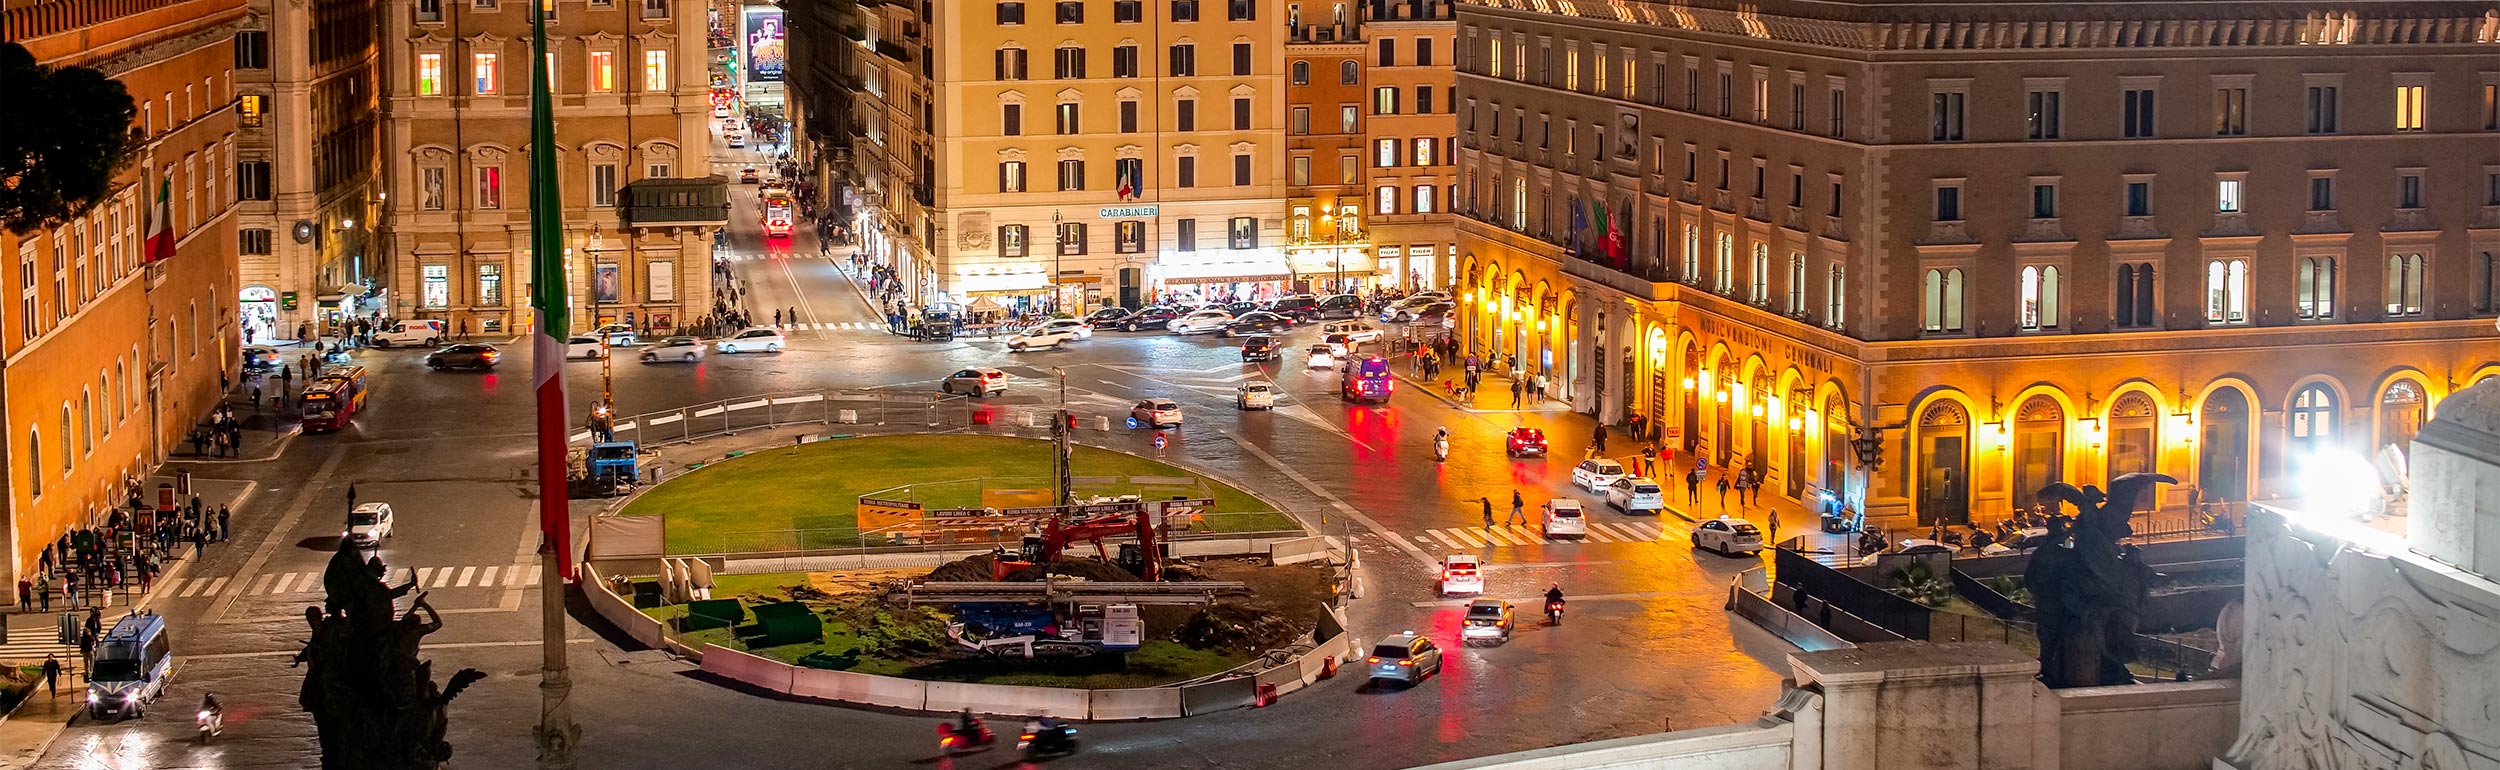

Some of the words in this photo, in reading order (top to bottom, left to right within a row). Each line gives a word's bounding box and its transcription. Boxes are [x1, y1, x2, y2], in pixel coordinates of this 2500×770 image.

[757, 46, 784, 58] NEW
[755, 58, 784, 70] POPE
[1100, 207, 1157, 217] CARABINIERI
[1784, 344, 1833, 375] GENERALI
